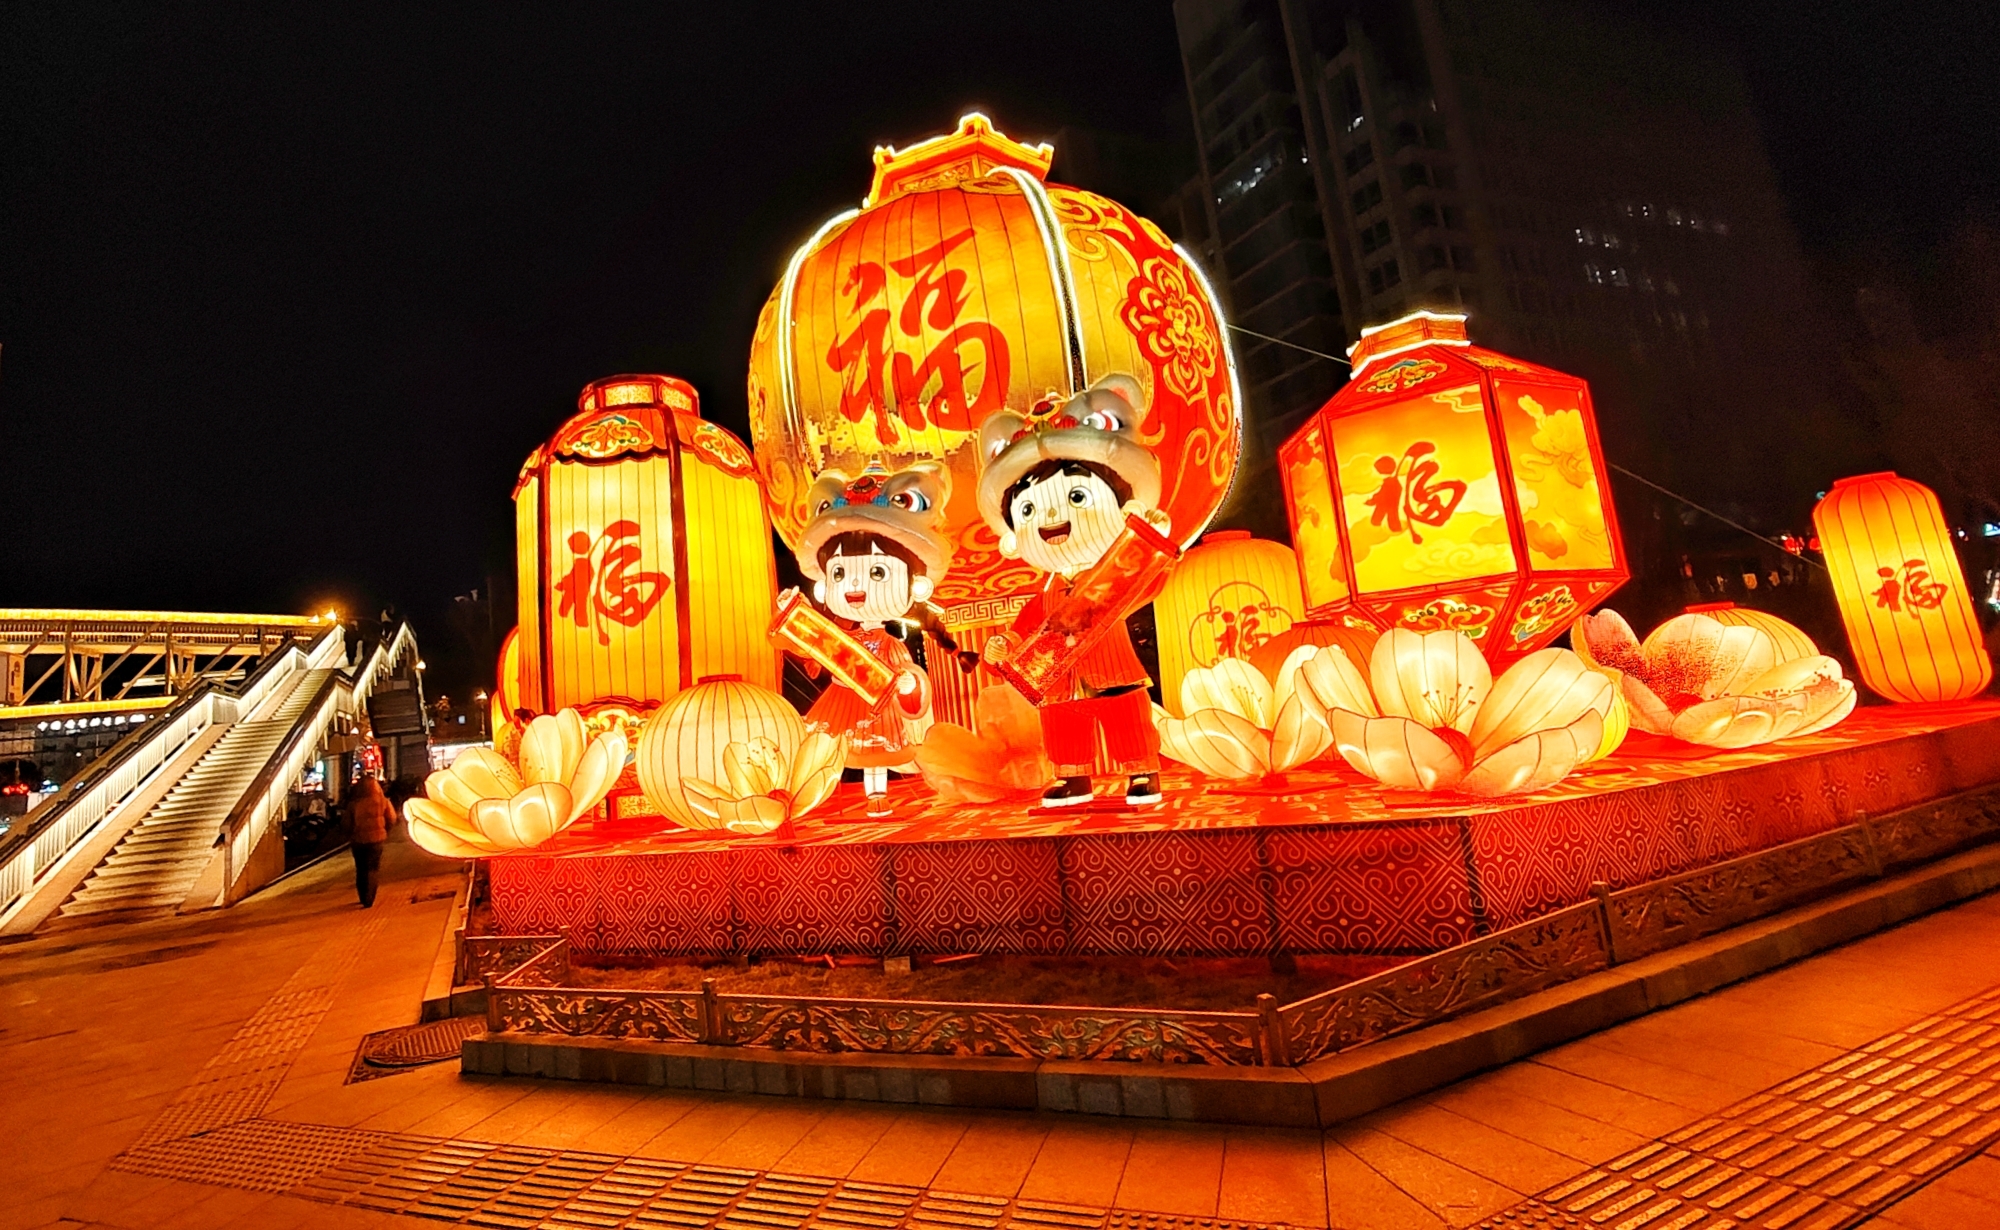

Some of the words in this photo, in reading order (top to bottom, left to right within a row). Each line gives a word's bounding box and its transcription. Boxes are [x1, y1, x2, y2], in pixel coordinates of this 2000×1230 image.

[826, 228, 1010, 446] 福
[1364, 441, 1467, 545] 福
[554, 520, 671, 646] 福
[1869, 559, 1948, 620] 福
